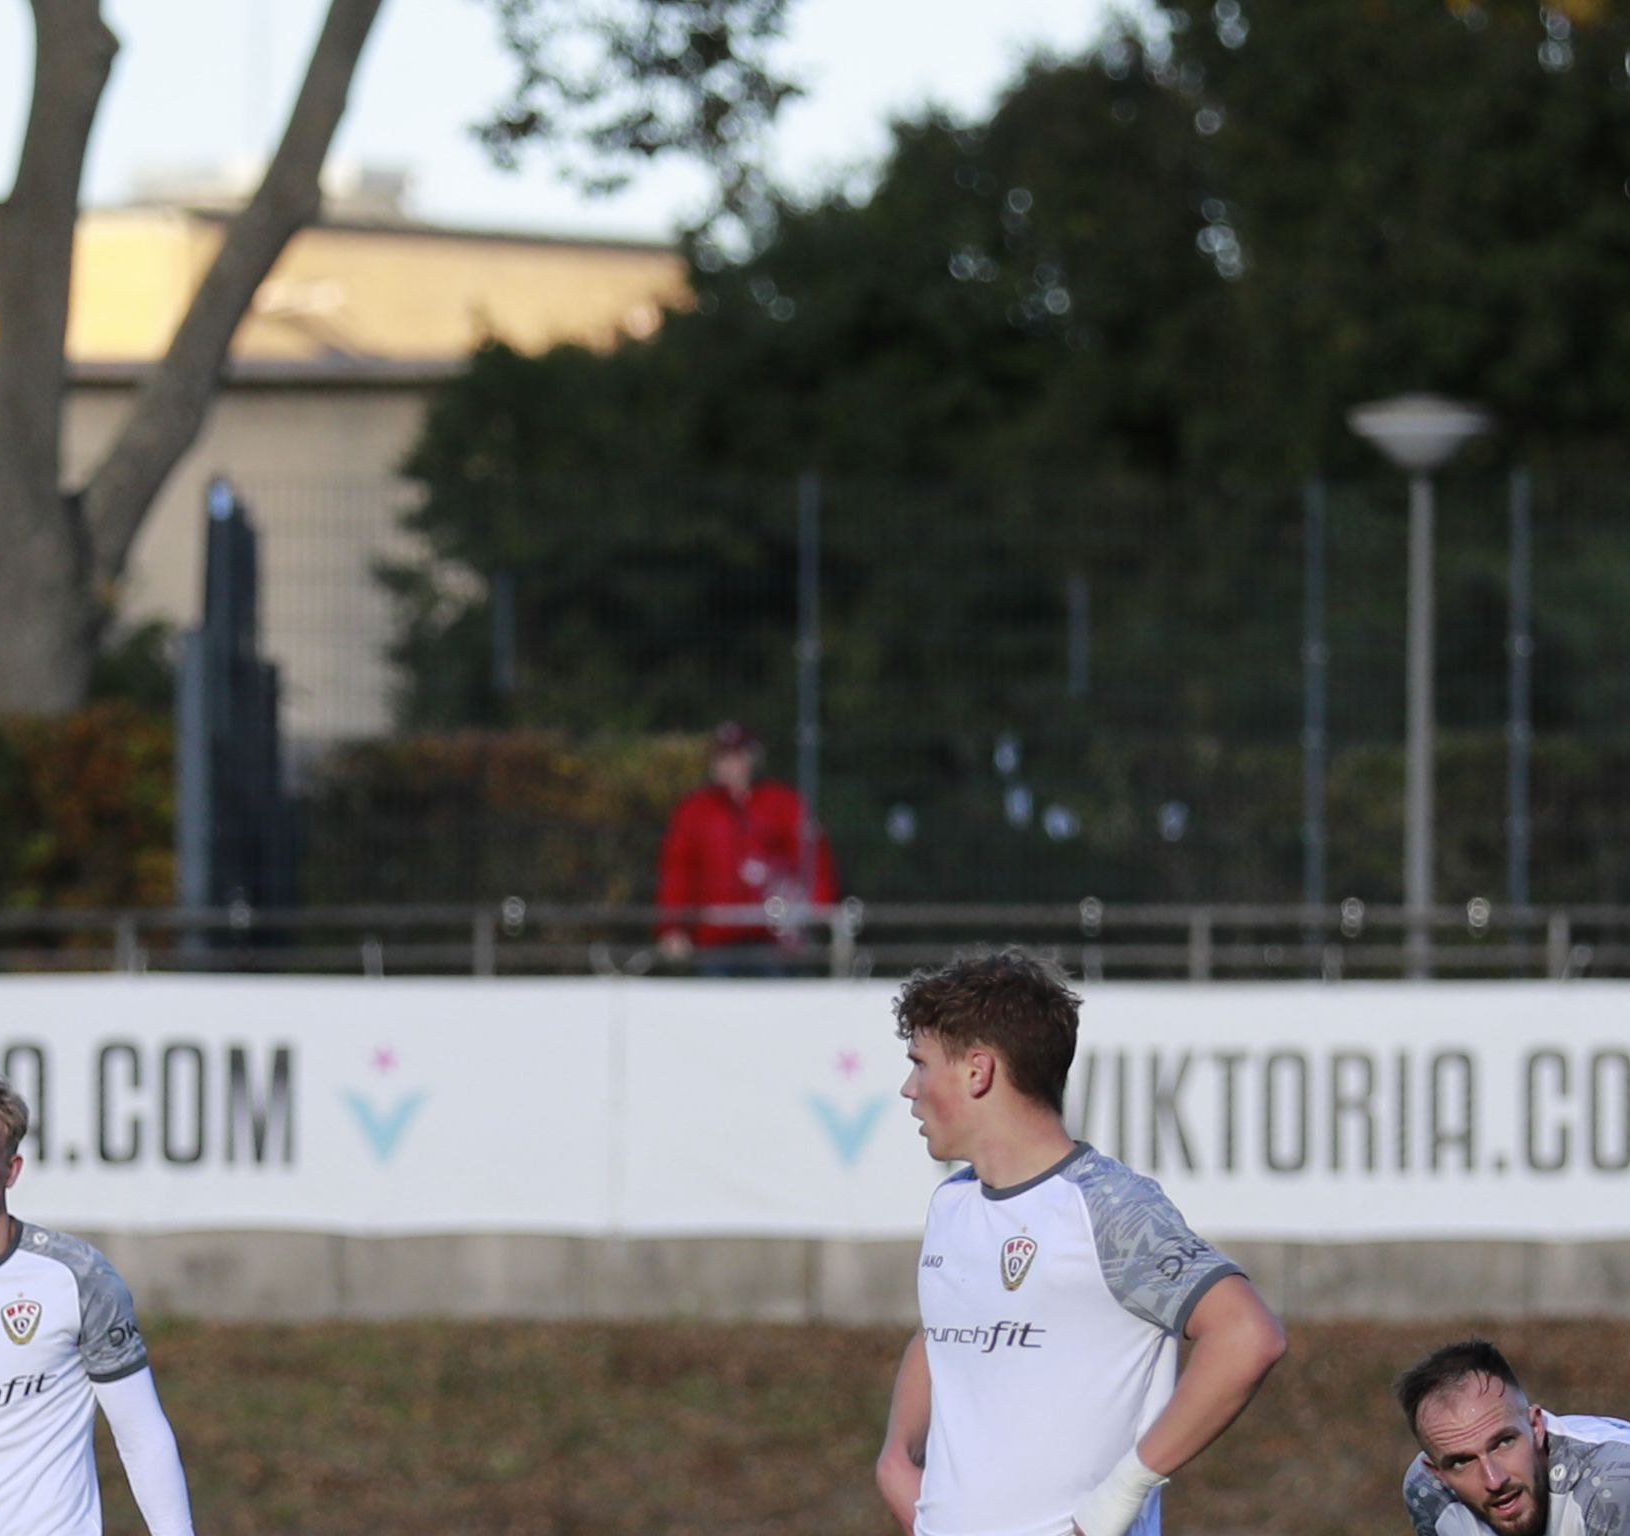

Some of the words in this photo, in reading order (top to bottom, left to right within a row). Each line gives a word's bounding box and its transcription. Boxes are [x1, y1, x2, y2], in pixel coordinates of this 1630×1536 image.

[1006, 1240, 1033, 1256] BFC
[6, 1302, 38, 1318] BFC
[923, 1320, 1047, 1353] runchfit
